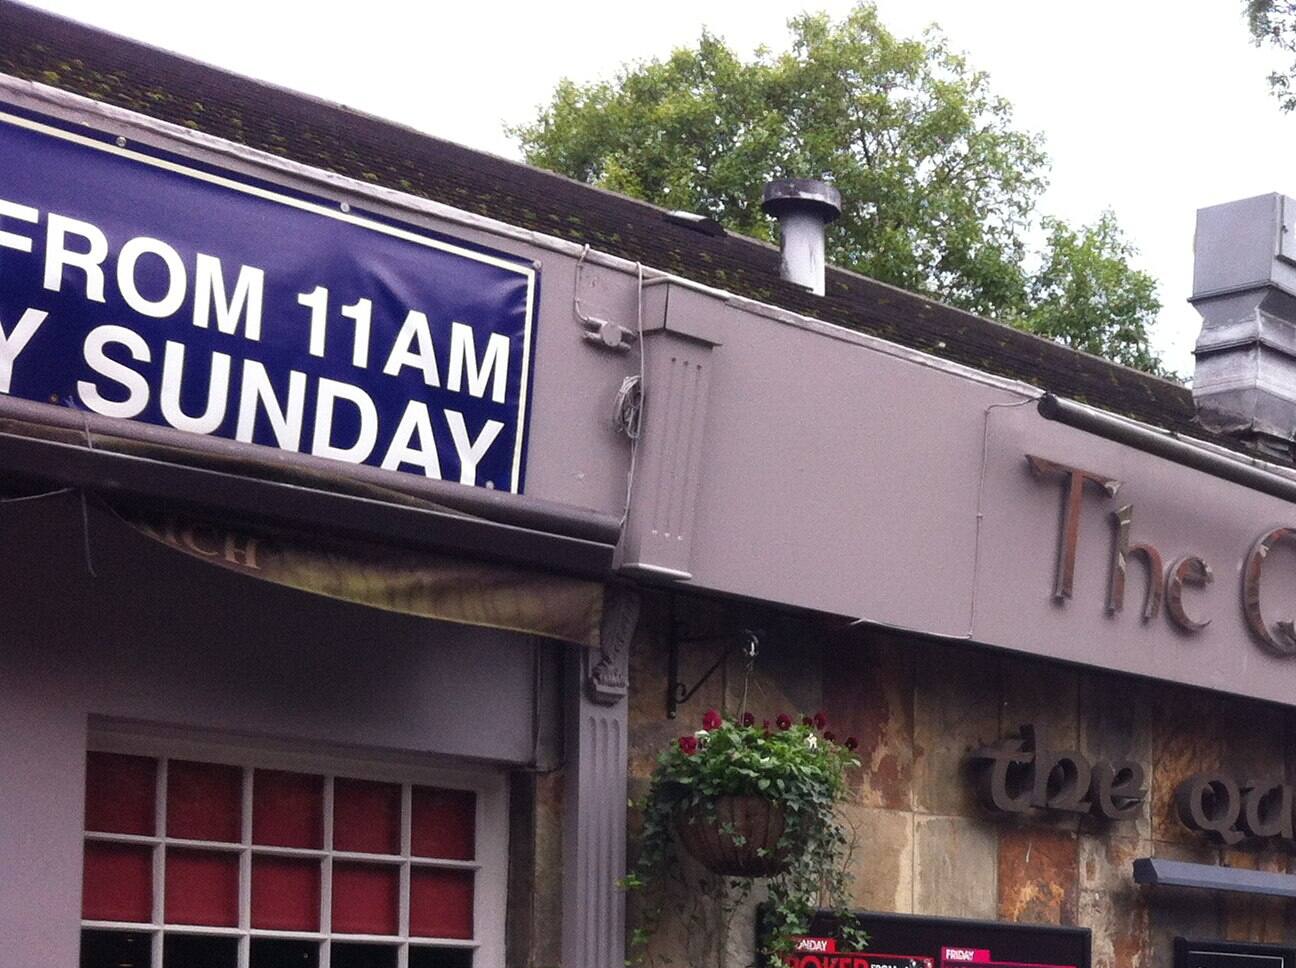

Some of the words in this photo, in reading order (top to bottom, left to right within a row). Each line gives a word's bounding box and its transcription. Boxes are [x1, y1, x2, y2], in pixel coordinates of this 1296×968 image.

[77, 325, 504, 486] SUNDAY
[298, 285, 510, 404] 11AM
[1025, 453, 1213, 632] The
[946, 949, 975, 960] FRIDAY
